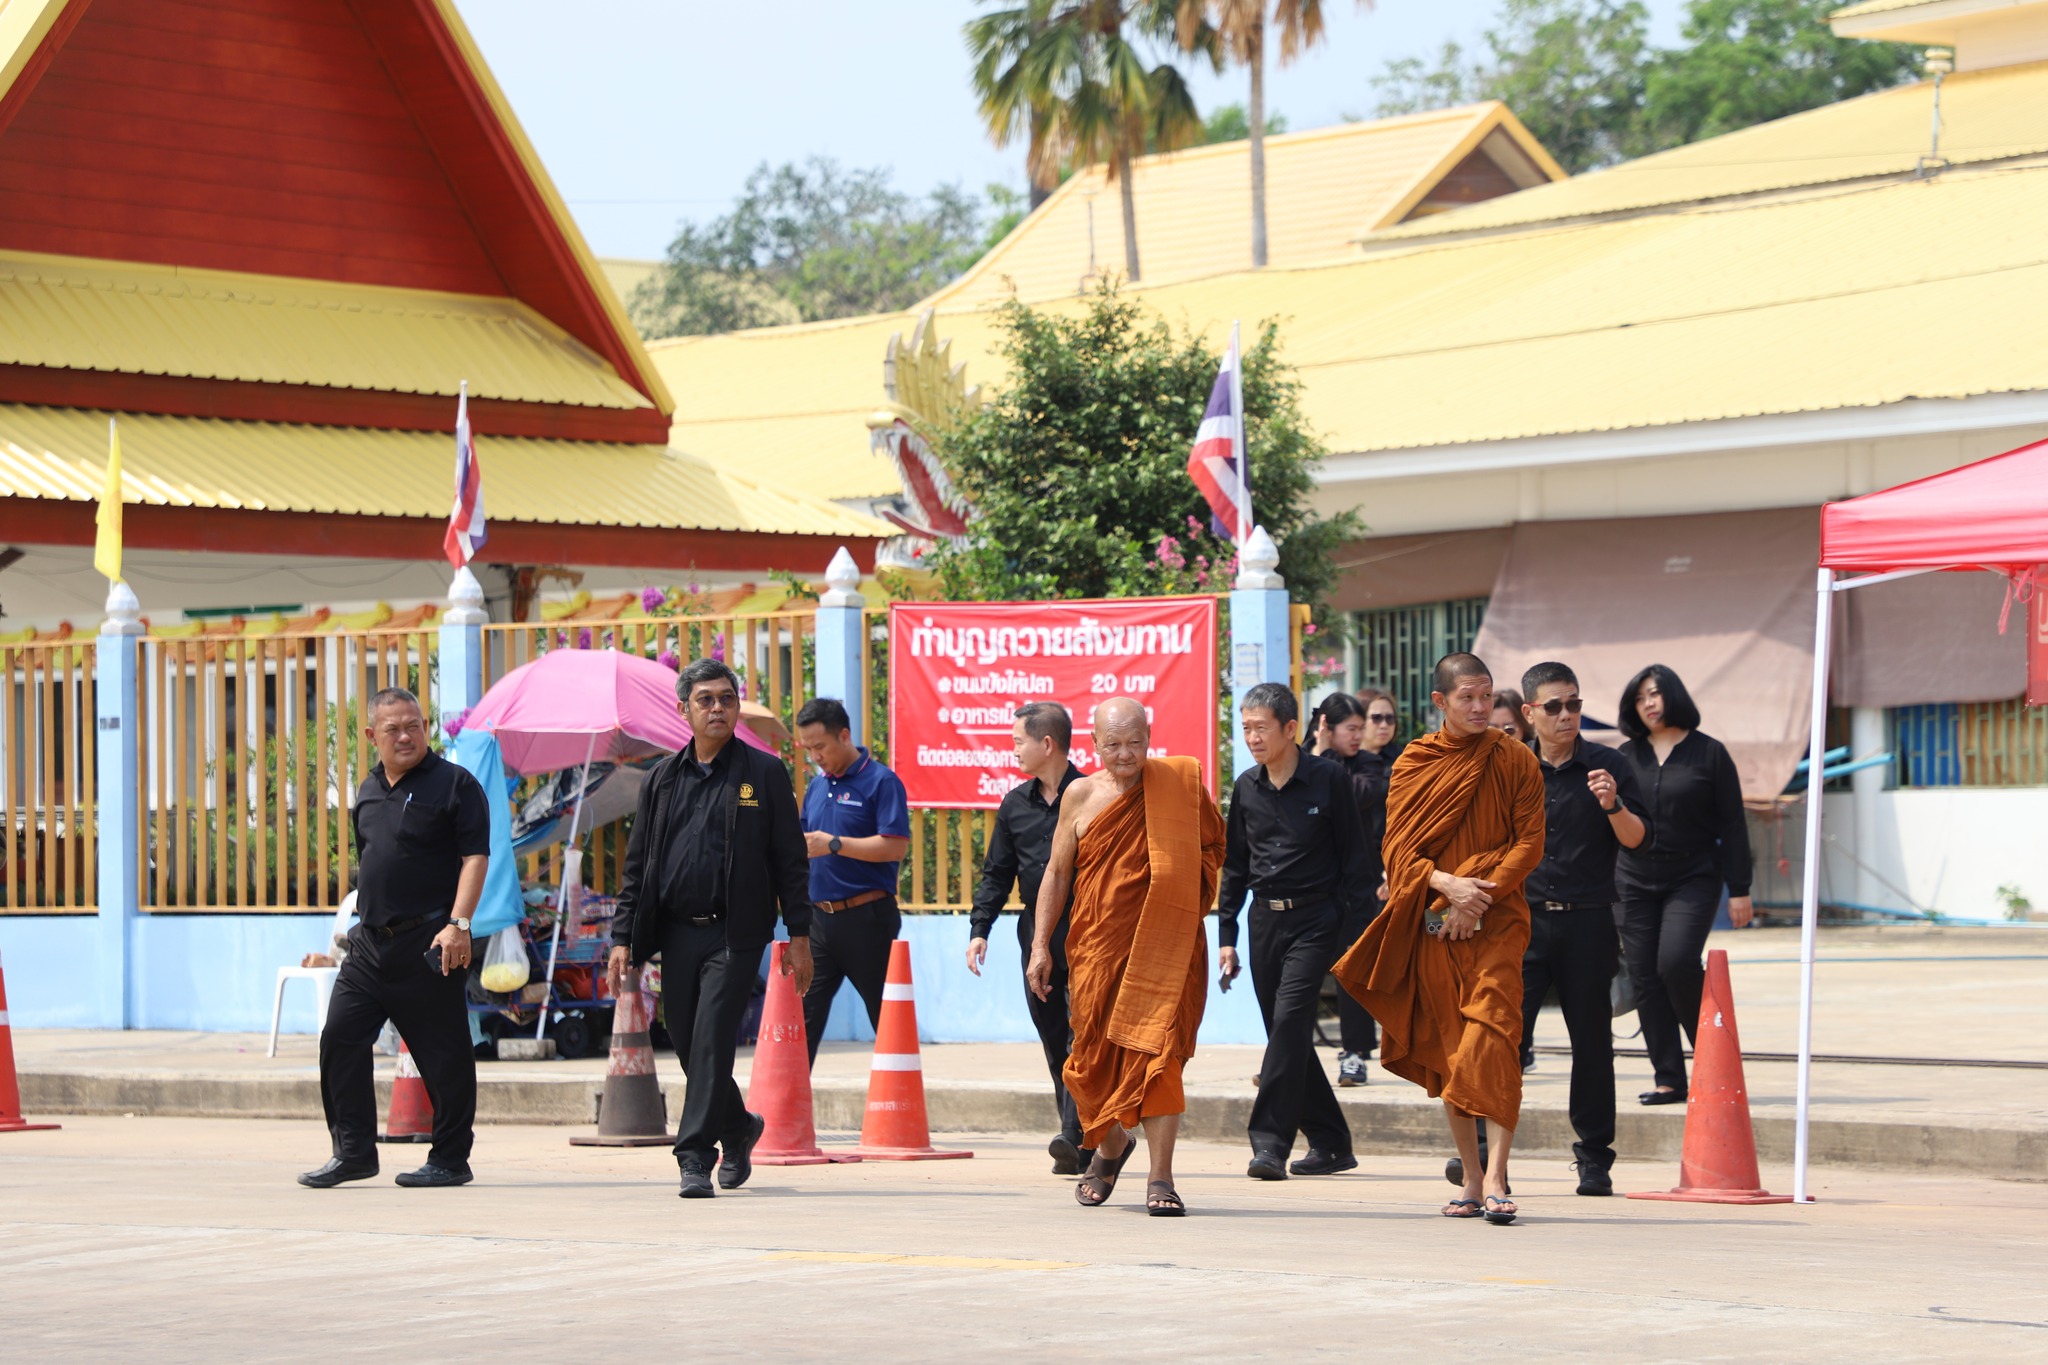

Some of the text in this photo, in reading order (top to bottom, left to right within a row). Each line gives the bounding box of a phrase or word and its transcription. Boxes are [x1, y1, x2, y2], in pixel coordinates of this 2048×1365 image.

[911, 617, 1193, 667] ทำบุญถวายสังฆทาน
[953, 670, 1155, 694] ขนมปังให้ปลา 20 บาท
